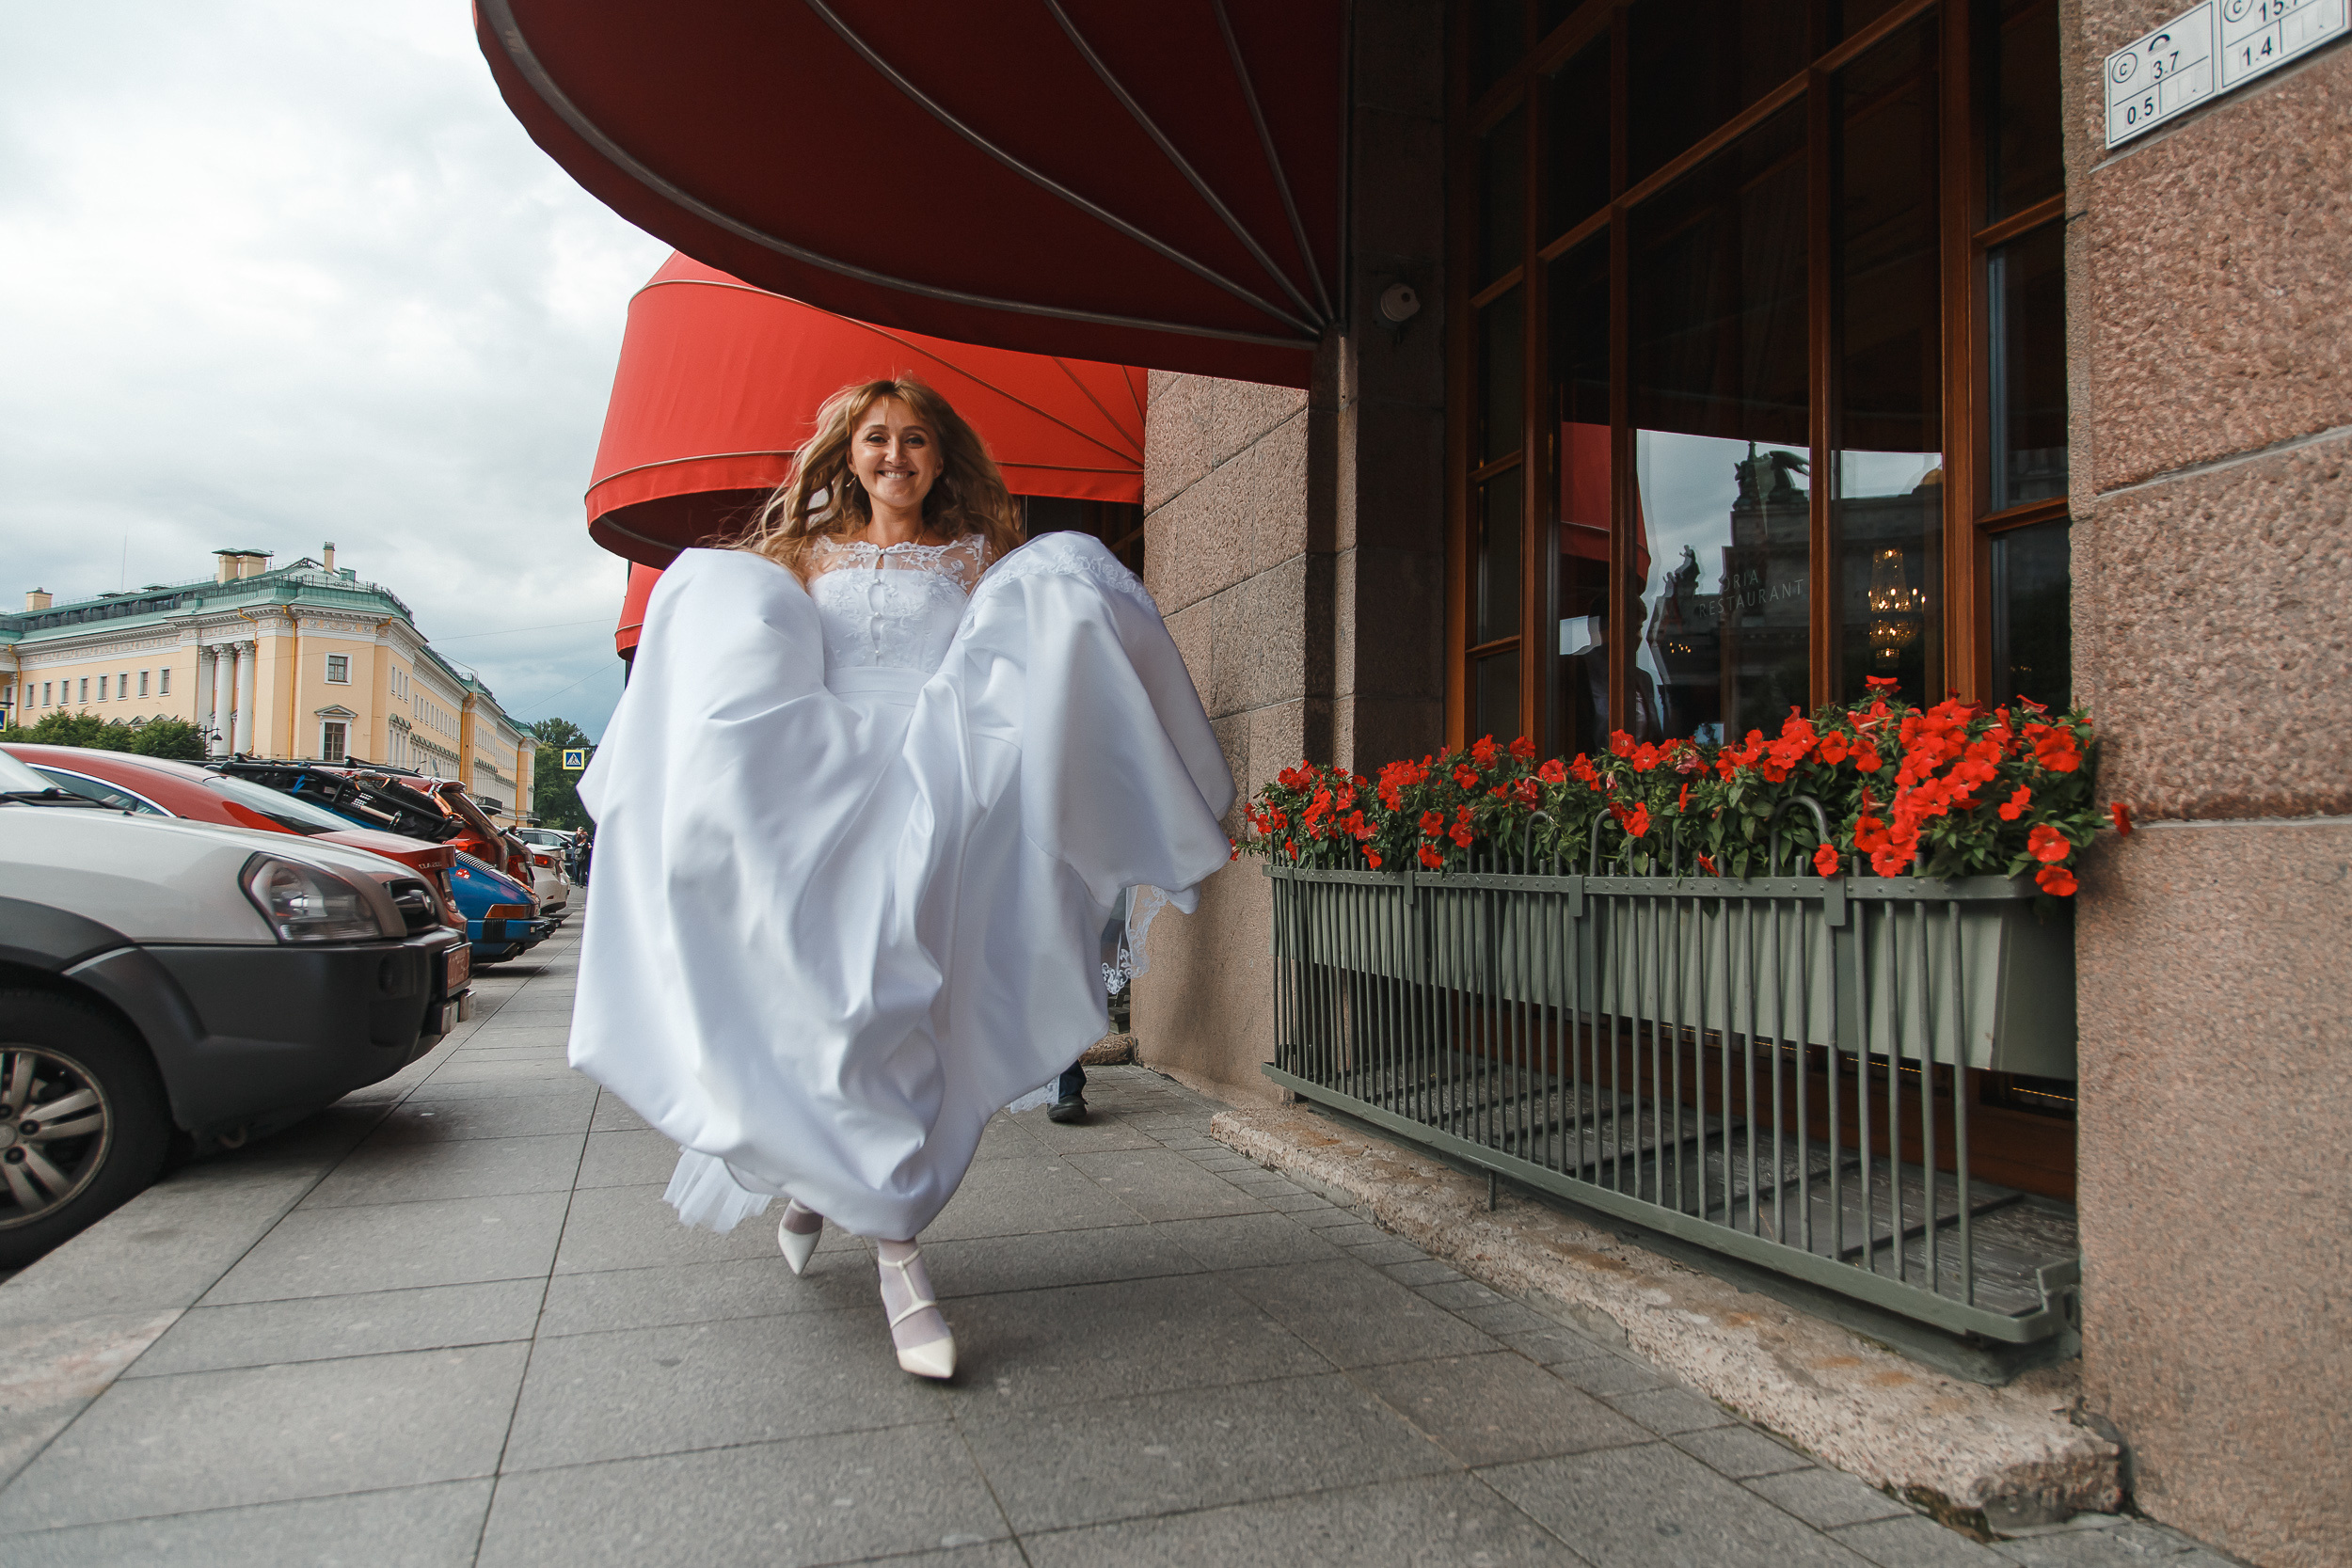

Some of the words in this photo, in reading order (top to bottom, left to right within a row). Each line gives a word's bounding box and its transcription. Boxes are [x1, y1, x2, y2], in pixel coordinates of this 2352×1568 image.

[2258, 0, 2296, 23] 15.
[2153, 50, 2180, 80] 3.7
[2242, 36, 2273, 67] 1.4
[2126, 96, 2154, 125] 0.5
[1698, 578, 1804, 619] RESTAURANT
